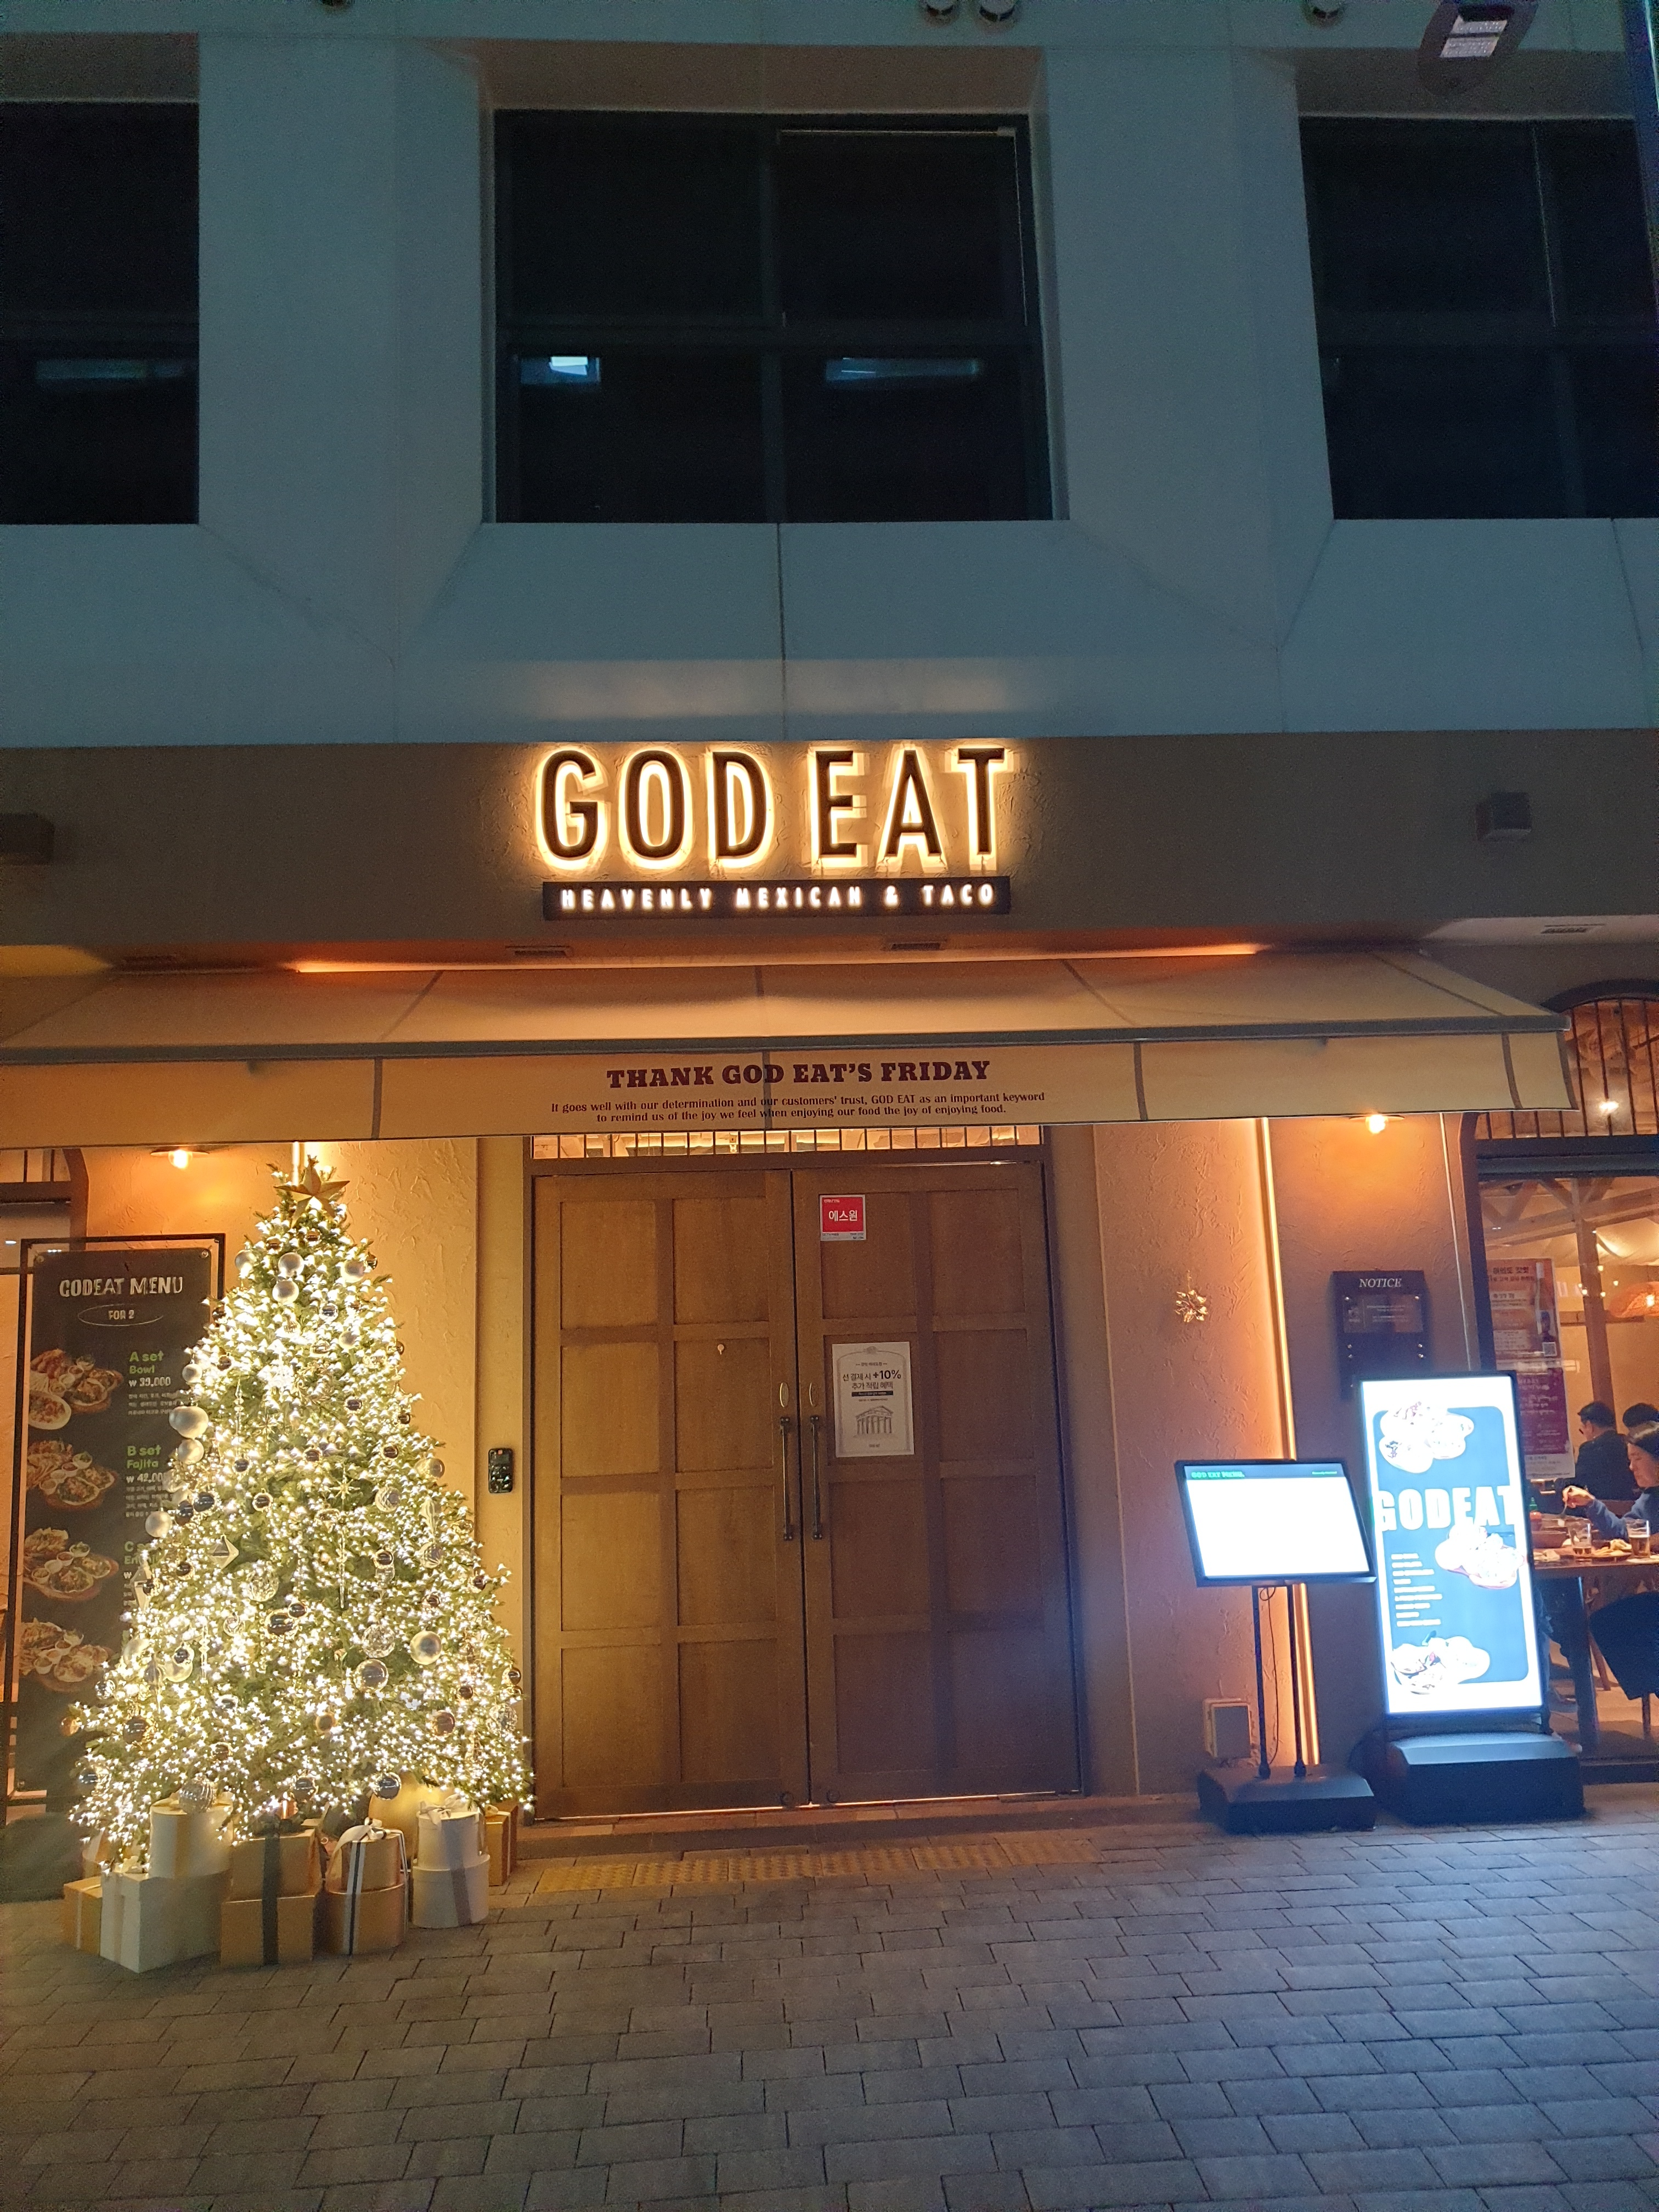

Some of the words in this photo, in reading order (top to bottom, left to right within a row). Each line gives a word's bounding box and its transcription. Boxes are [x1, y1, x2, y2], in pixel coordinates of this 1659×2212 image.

[541, 749, 768, 860] GOD
[815, 747, 1005, 857] EAT
[561, 888, 712, 911] HEAVENLY
[736, 886, 861, 909] MEXICAN
[884, 885, 899, 907] &
[922, 883, 994, 906] TACO
[607, 1066, 714, 1088] THANK
[722, 1064, 785, 1085] GOD
[793, 1063, 872, 1083] EAT'S
[881, 1060, 990, 1082] FRIDAY
[551, 1103, 558, 1112] It
[562, 1103, 587, 1114] goes
[590, 1102, 611, 1111] well
[615, 1101, 636, 1110] with
[640, 1102, 659, 1110] our
[662, 1098, 734, 1109] determination
[737, 1097, 757, 1107] and
[760, 1098, 778, 1106] our
[871, 1094, 894, 1104] GOD
[898, 1094, 915, 1103] EAT
[951, 1093, 1000, 1104] important
[1003, 1092, 1045, 1103] keyword
[611, 1113, 648, 1121] remind
[668, 1111, 678, 1120] of
[682, 1111, 698, 1120] the
[702, 1110, 716, 1121] joy
[738, 1109, 756, 1118] feel
[760, 1108, 787, 1118] when
[791, 1108, 834, 1119] enjoying
[858, 1107, 881, 1116] food
[884, 1106, 900, 1115] the
[904, 1106, 918, 1116] joy
[922, 1106, 932, 1114] of
[935, 1105, 978, 1115] enjoying
[981, 1104, 1006, 1113] food.
[828, 1210, 857, 1222] 에스원
[59, 1278, 125, 1297] GODEAT
[129, 1277, 183, 1295] MENU
[1359, 1278, 1402, 1288] NOTICE
[109, 1310, 126, 1320] FOR
[128, 1309, 135, 1319] 2
[129, 1351, 139, 1362] A
[142, 1350, 164, 1361] set
[129, 1365, 155, 1374] Bowl
[872, 1369, 901, 1379] +10%
[866, 1381, 879, 1390] 적립
[127, 1446, 136, 1456] B
[139, 1444, 161, 1456] set
[127, 1459, 159, 1470] Fajita
[1374, 1485, 1519, 1532] GODEAT
